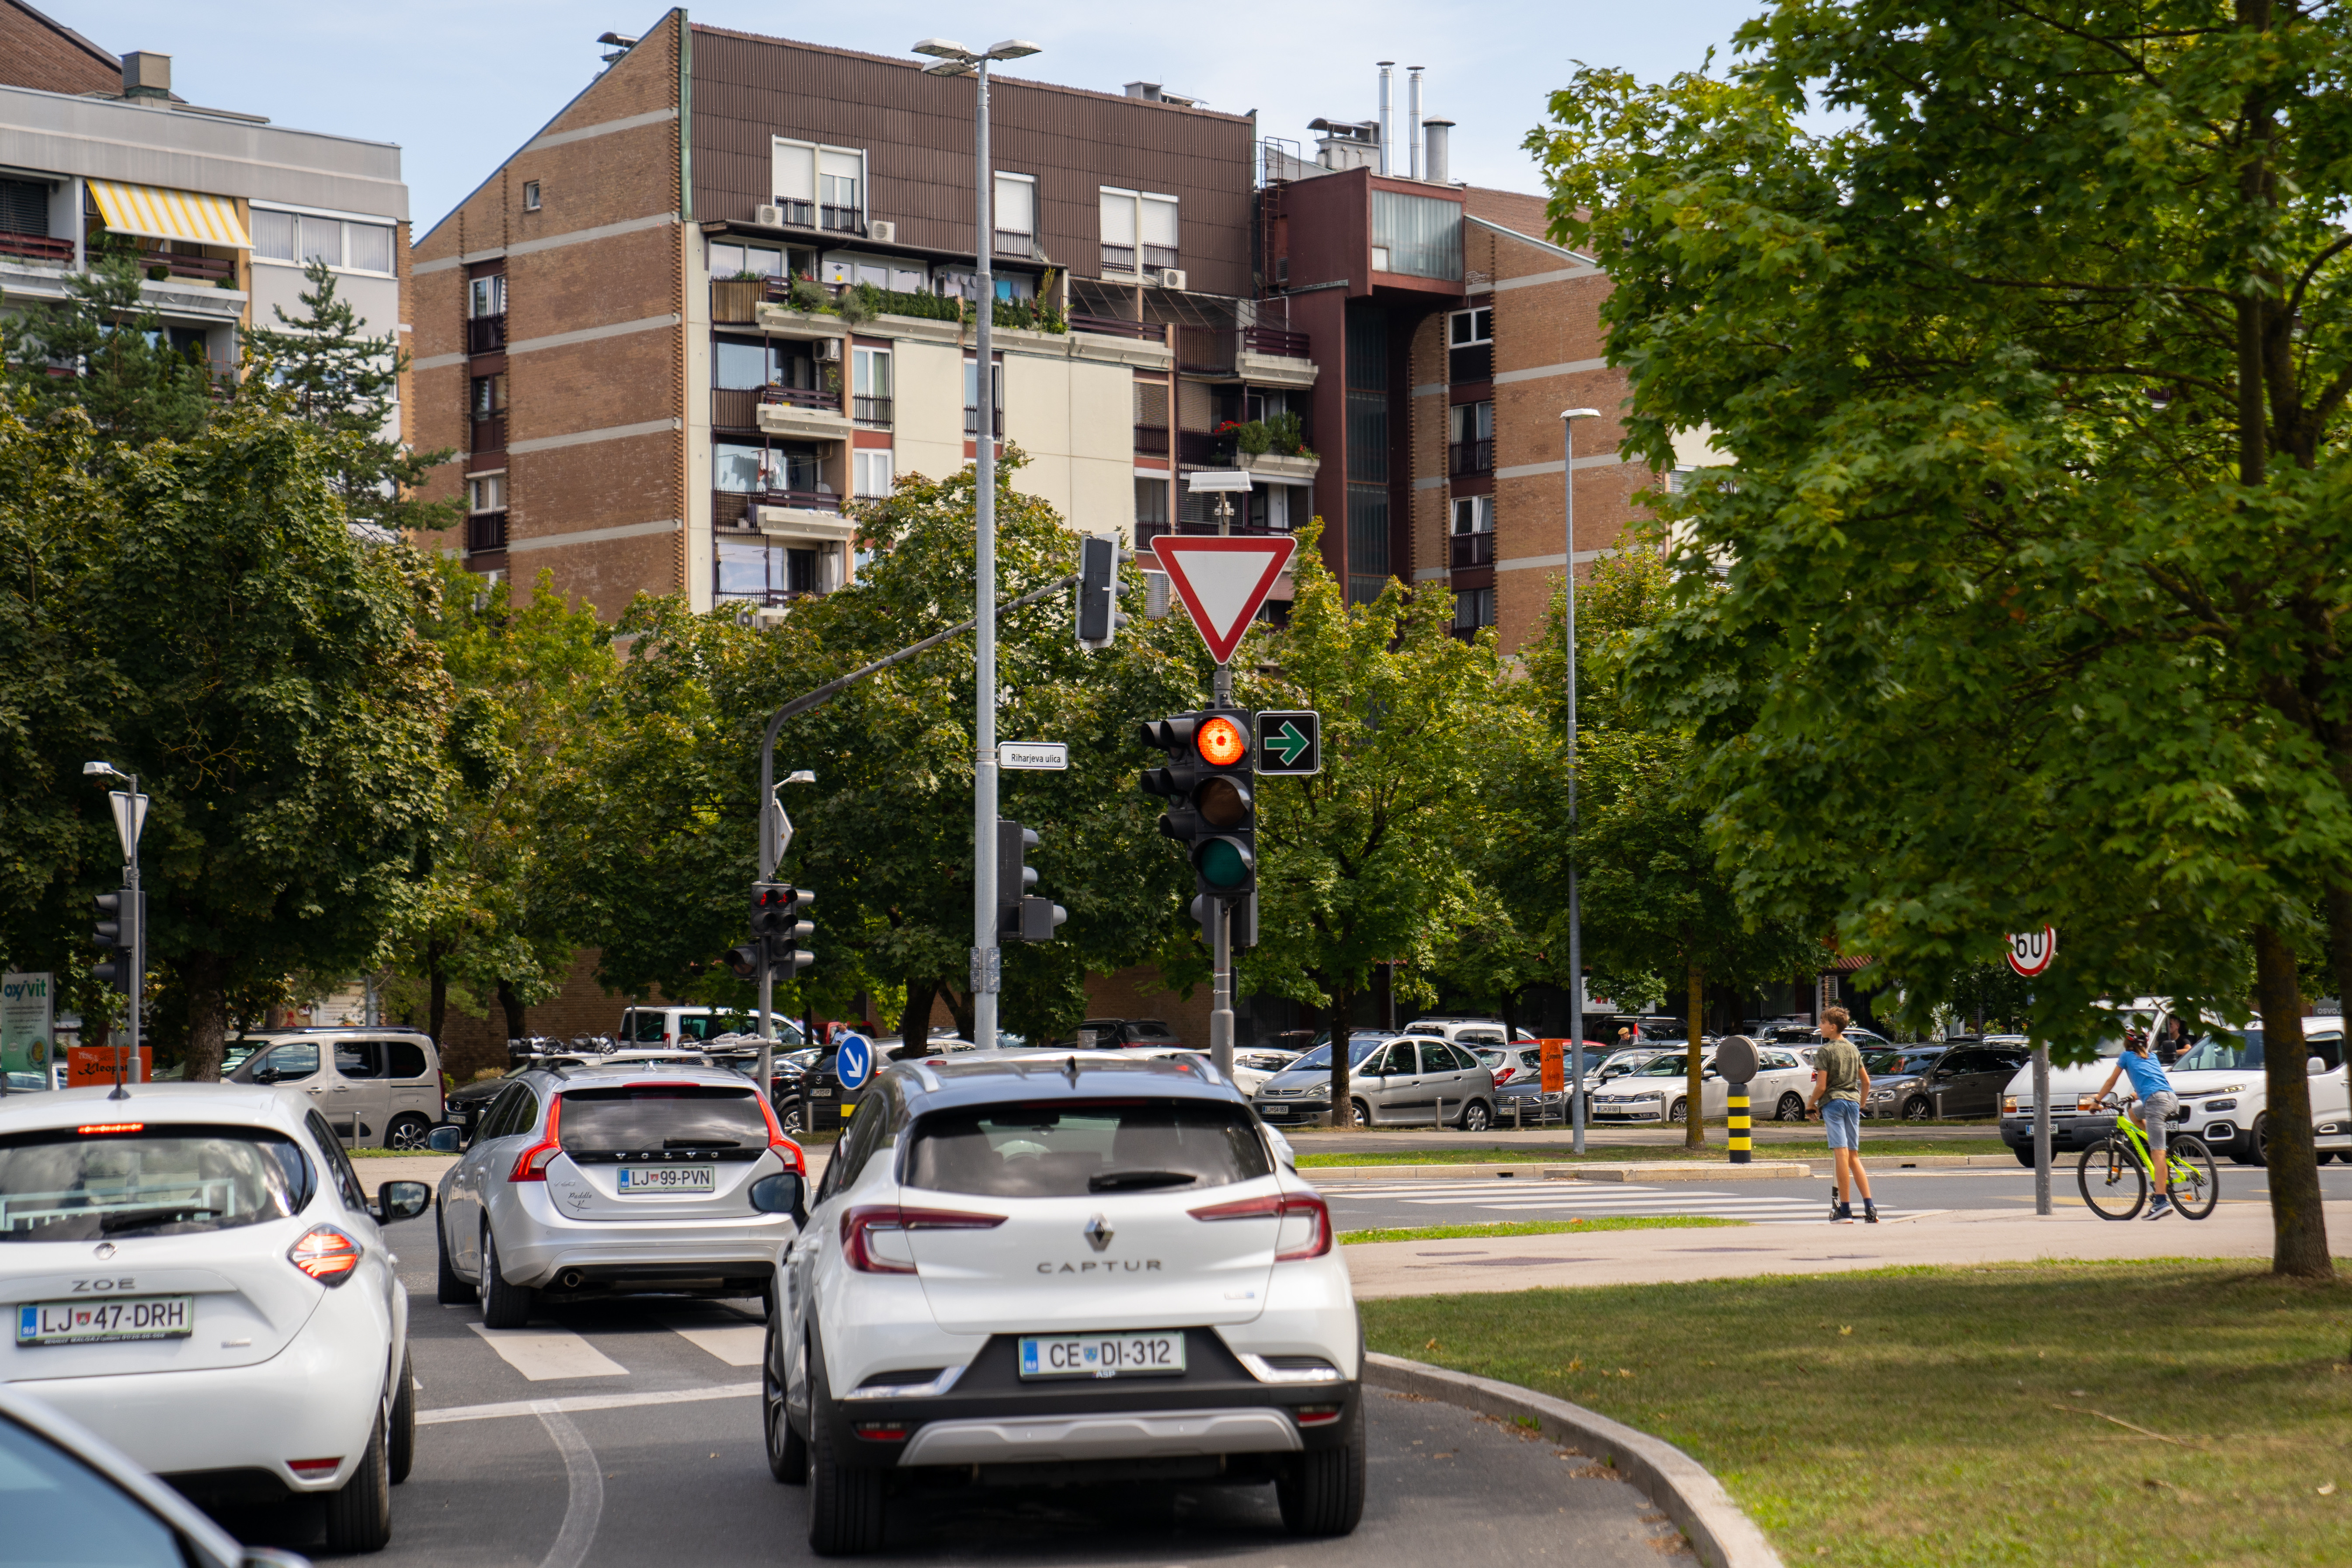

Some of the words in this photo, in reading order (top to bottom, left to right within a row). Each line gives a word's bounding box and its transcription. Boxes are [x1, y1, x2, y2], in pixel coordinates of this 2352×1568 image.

[1011, 754, 1043, 764] Riharjeva
[1045, 754, 1061, 763] ulica
[78, 1063, 128, 1075] Kleopat
[615, 1151, 719, 1160] VOLVO
[632, 1171, 649, 1186] LJ
[660, 1170, 710, 1186] 99-PVN
[1037, 1259, 1162, 1274] CAPTUR
[71, 1276, 136, 1293] ZOE
[42, 1307, 73, 1333] LJ
[93, 1301, 184, 1330] 47-DRH
[1050, 1342, 1081, 1369] CE
[1101, 1339, 1171, 1366] DI-312
